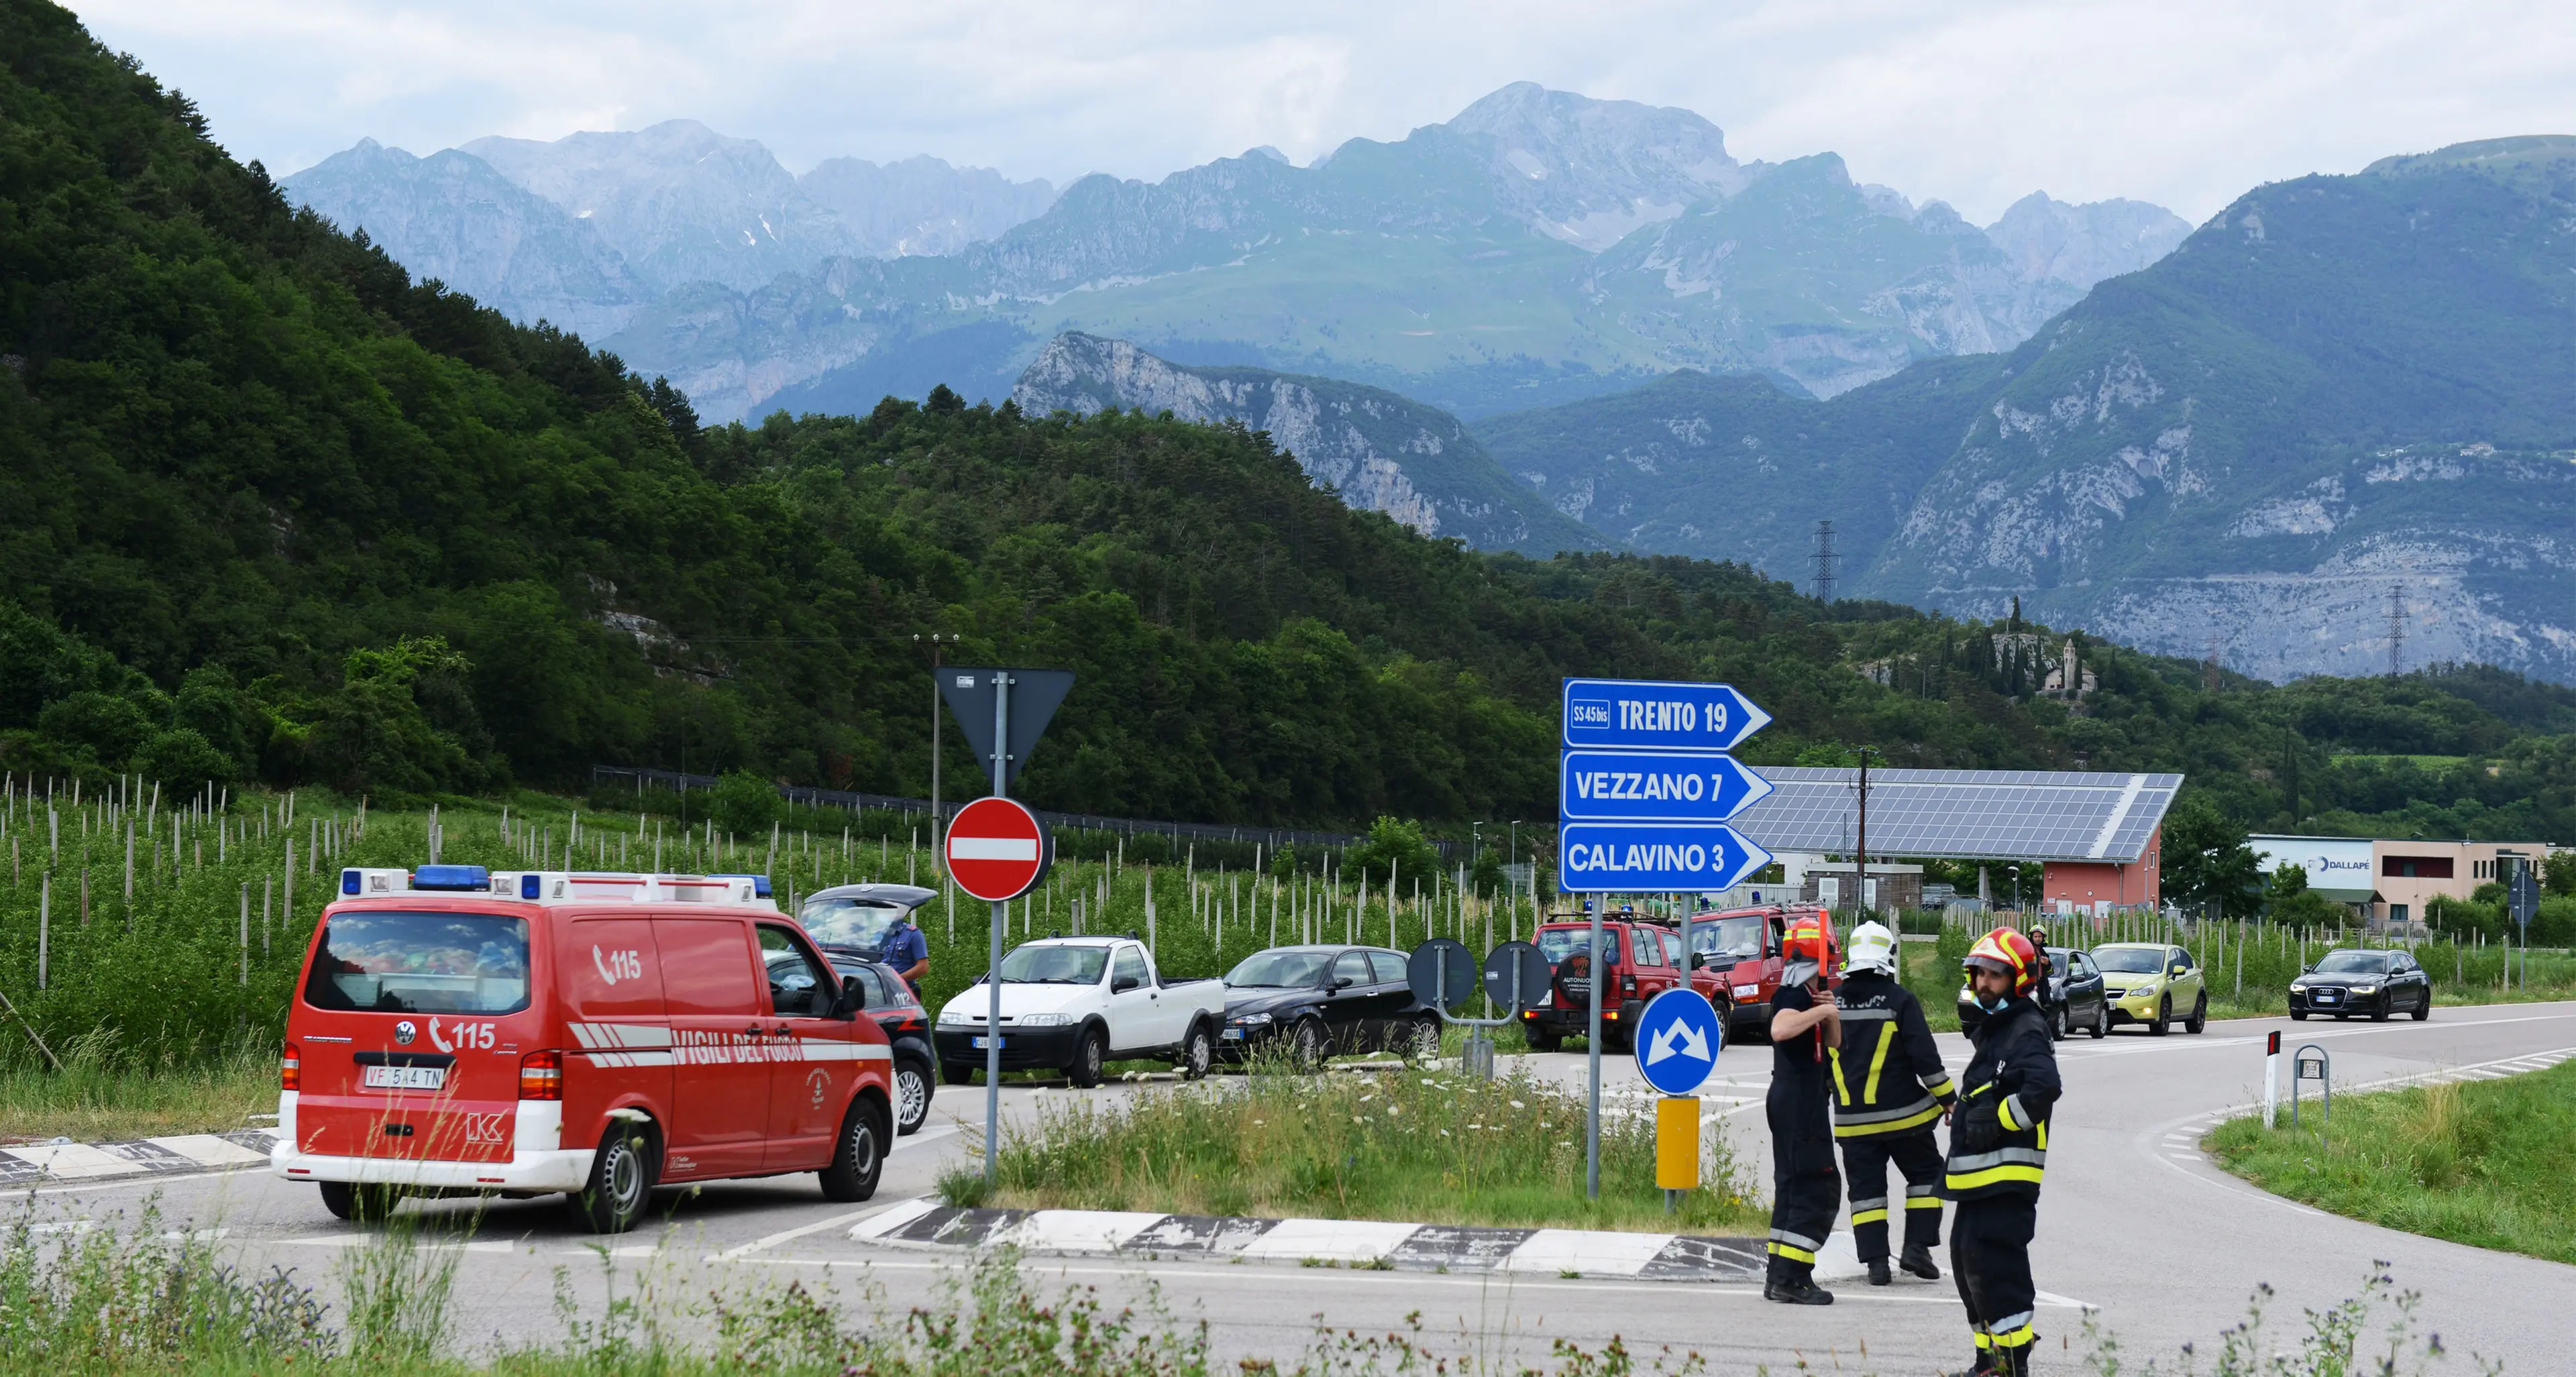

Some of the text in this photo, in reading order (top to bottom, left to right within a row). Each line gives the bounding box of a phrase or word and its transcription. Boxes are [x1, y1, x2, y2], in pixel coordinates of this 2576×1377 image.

[1574, 706, 1584, 722] SS
[1618, 700, 1728, 732] TRENTO 19
[1575, 772, 1723, 802] VEZZANO 7
[1568, 843, 1724, 873] CALAVINO 3
[2330, 859, 2369, 869] DALLAPÉ
[610, 950, 641, 979] 115
[895, 993, 911, 1005] 112
[1835, 996, 1847, 1008] EL
[451, 1022, 496, 1049] 115
[671, 1030, 802, 1064] VIGILI DEL FUOCO
[370, 1068, 386, 1083] VF
[425, 1070, 441, 1087] TN
